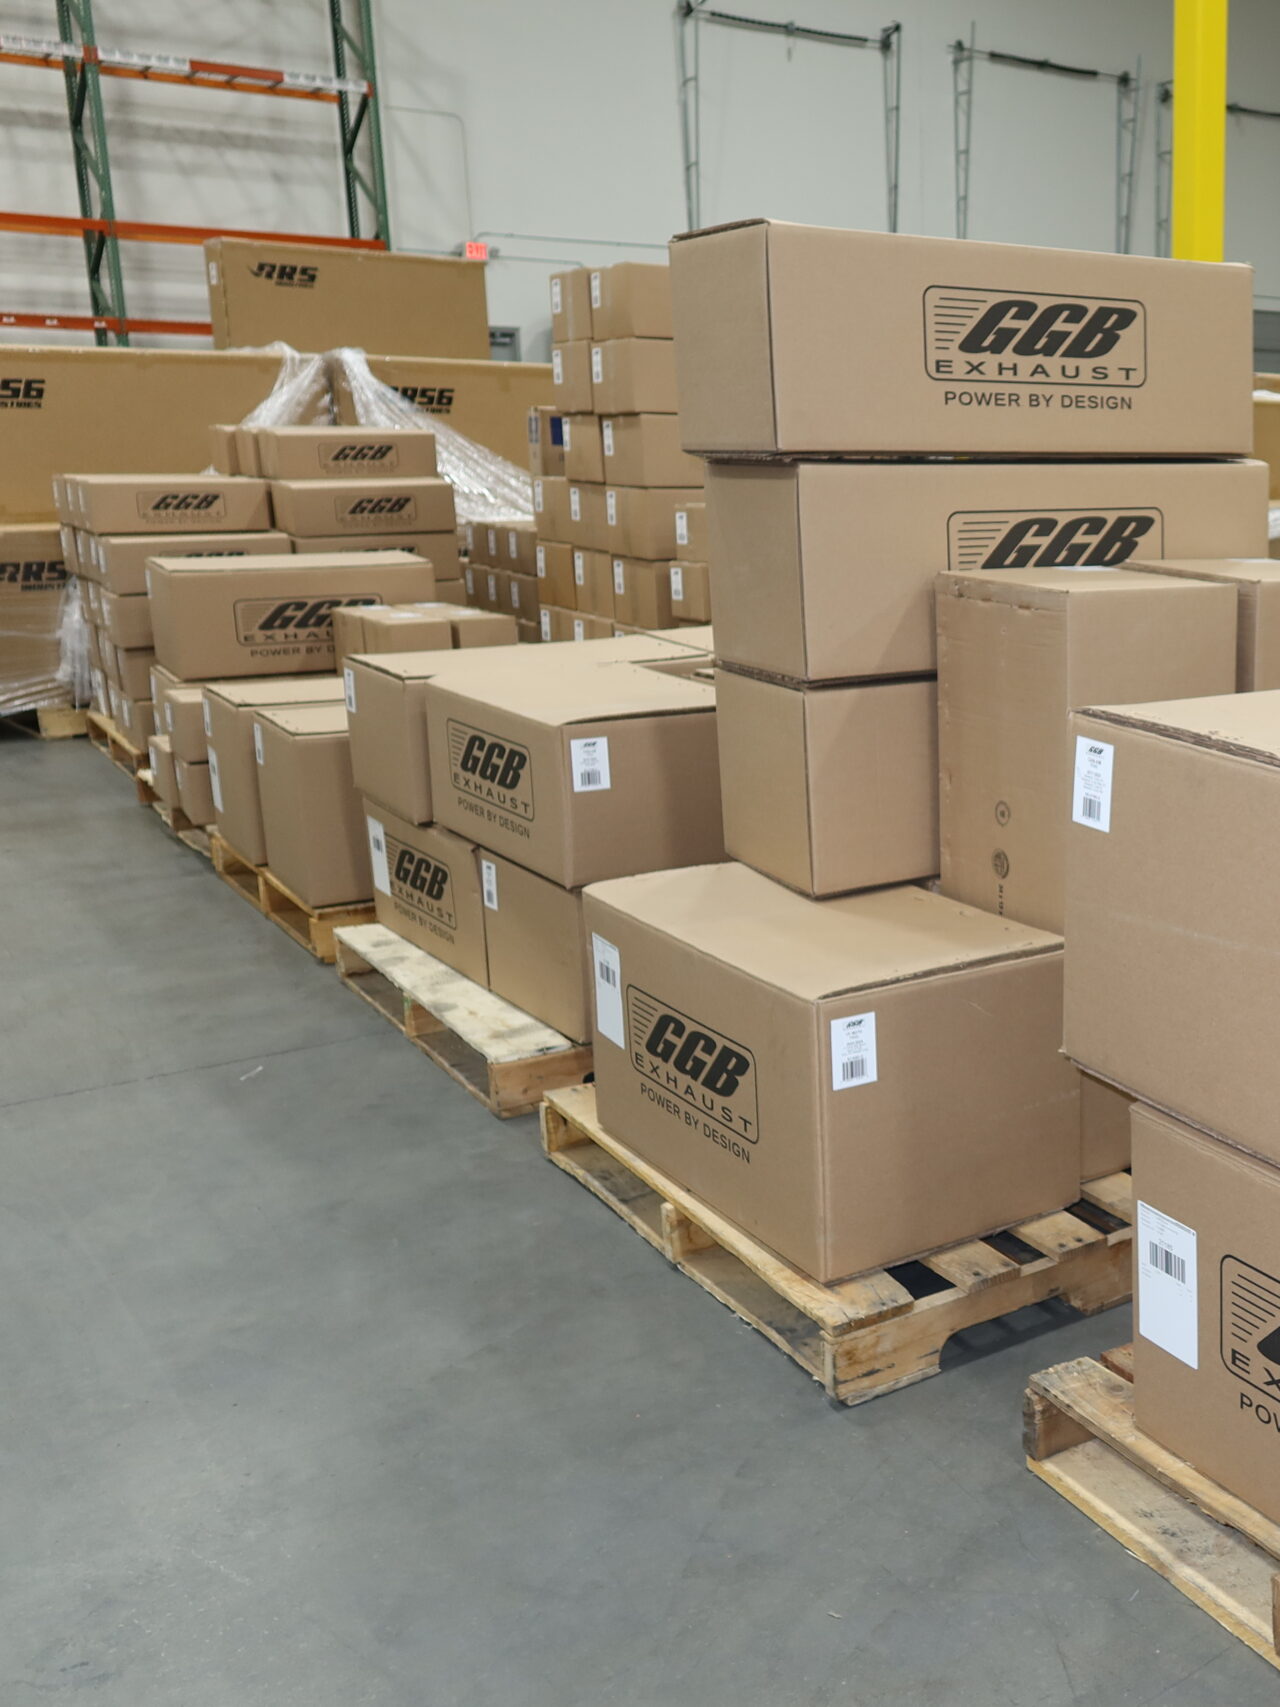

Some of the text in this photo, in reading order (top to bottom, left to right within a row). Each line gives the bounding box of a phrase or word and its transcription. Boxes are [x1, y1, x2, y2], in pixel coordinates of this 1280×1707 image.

[958, 300, 1138, 359] GGB
[935, 359, 1138, 381] EXHAUST
[944, 390, 1132, 410] POWER BY DESIGN
[981, 515, 1155, 569] GGB
[258, 598, 376, 631] GG
[460, 734, 527, 790] GGB
[453, 772, 530, 814] EXHAUST
[457, 796, 530, 839] POWER BY DESIGN
[395, 849, 448, 901] GGB
[645, 1013, 750, 1098] GGB
[635, 1052, 752, 1134] EXHAUST
[640, 1082, 751, 1164] POWER BY DESIGN
